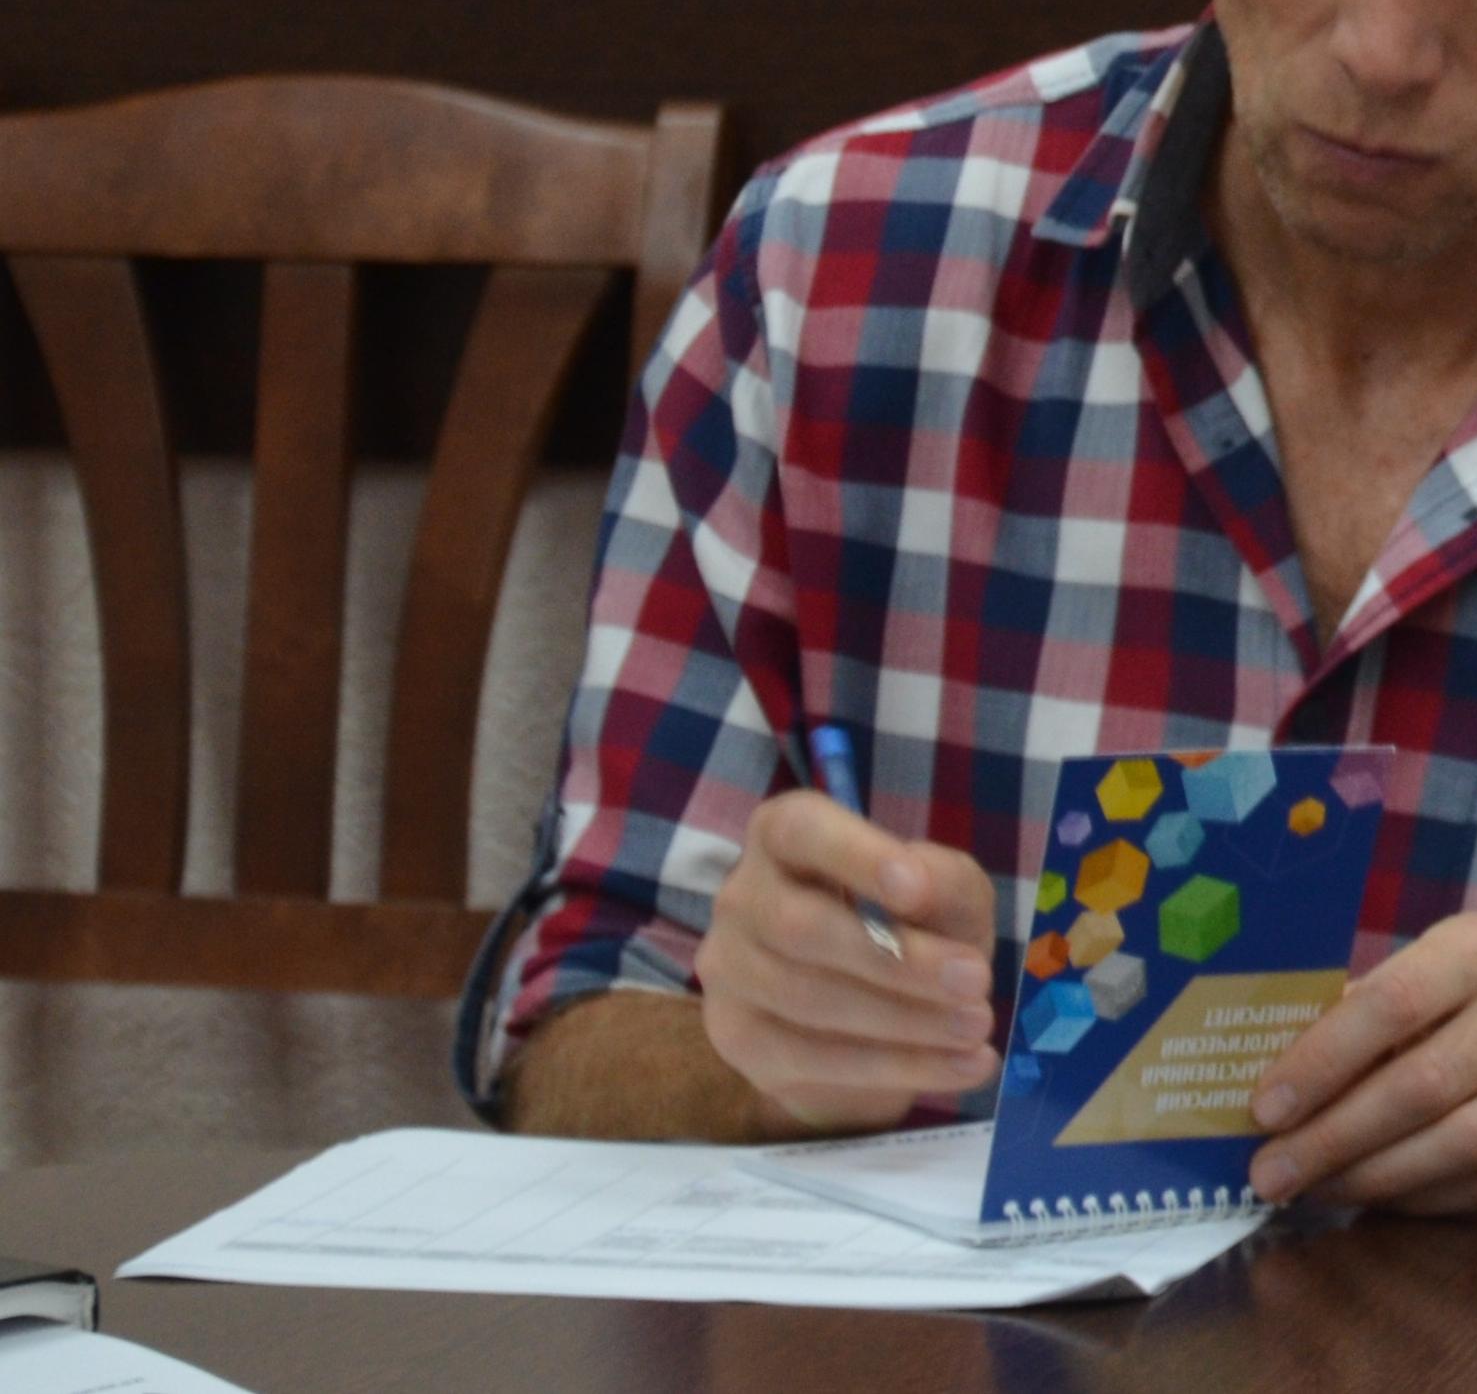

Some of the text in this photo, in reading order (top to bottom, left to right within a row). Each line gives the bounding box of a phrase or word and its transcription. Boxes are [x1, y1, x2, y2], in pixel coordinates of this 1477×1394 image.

[1204, 1003, 1321, 1027] УНИВЕРСИТЕТ
[1161, 1030, 1297, 1056] ДАГОГИЧЕСКИЙ
[1141, 1060, 1272, 1087] ДАРСТВЕННЫЙ
[1156, 1090, 1249, 1113] ИБИРСКИЙ
